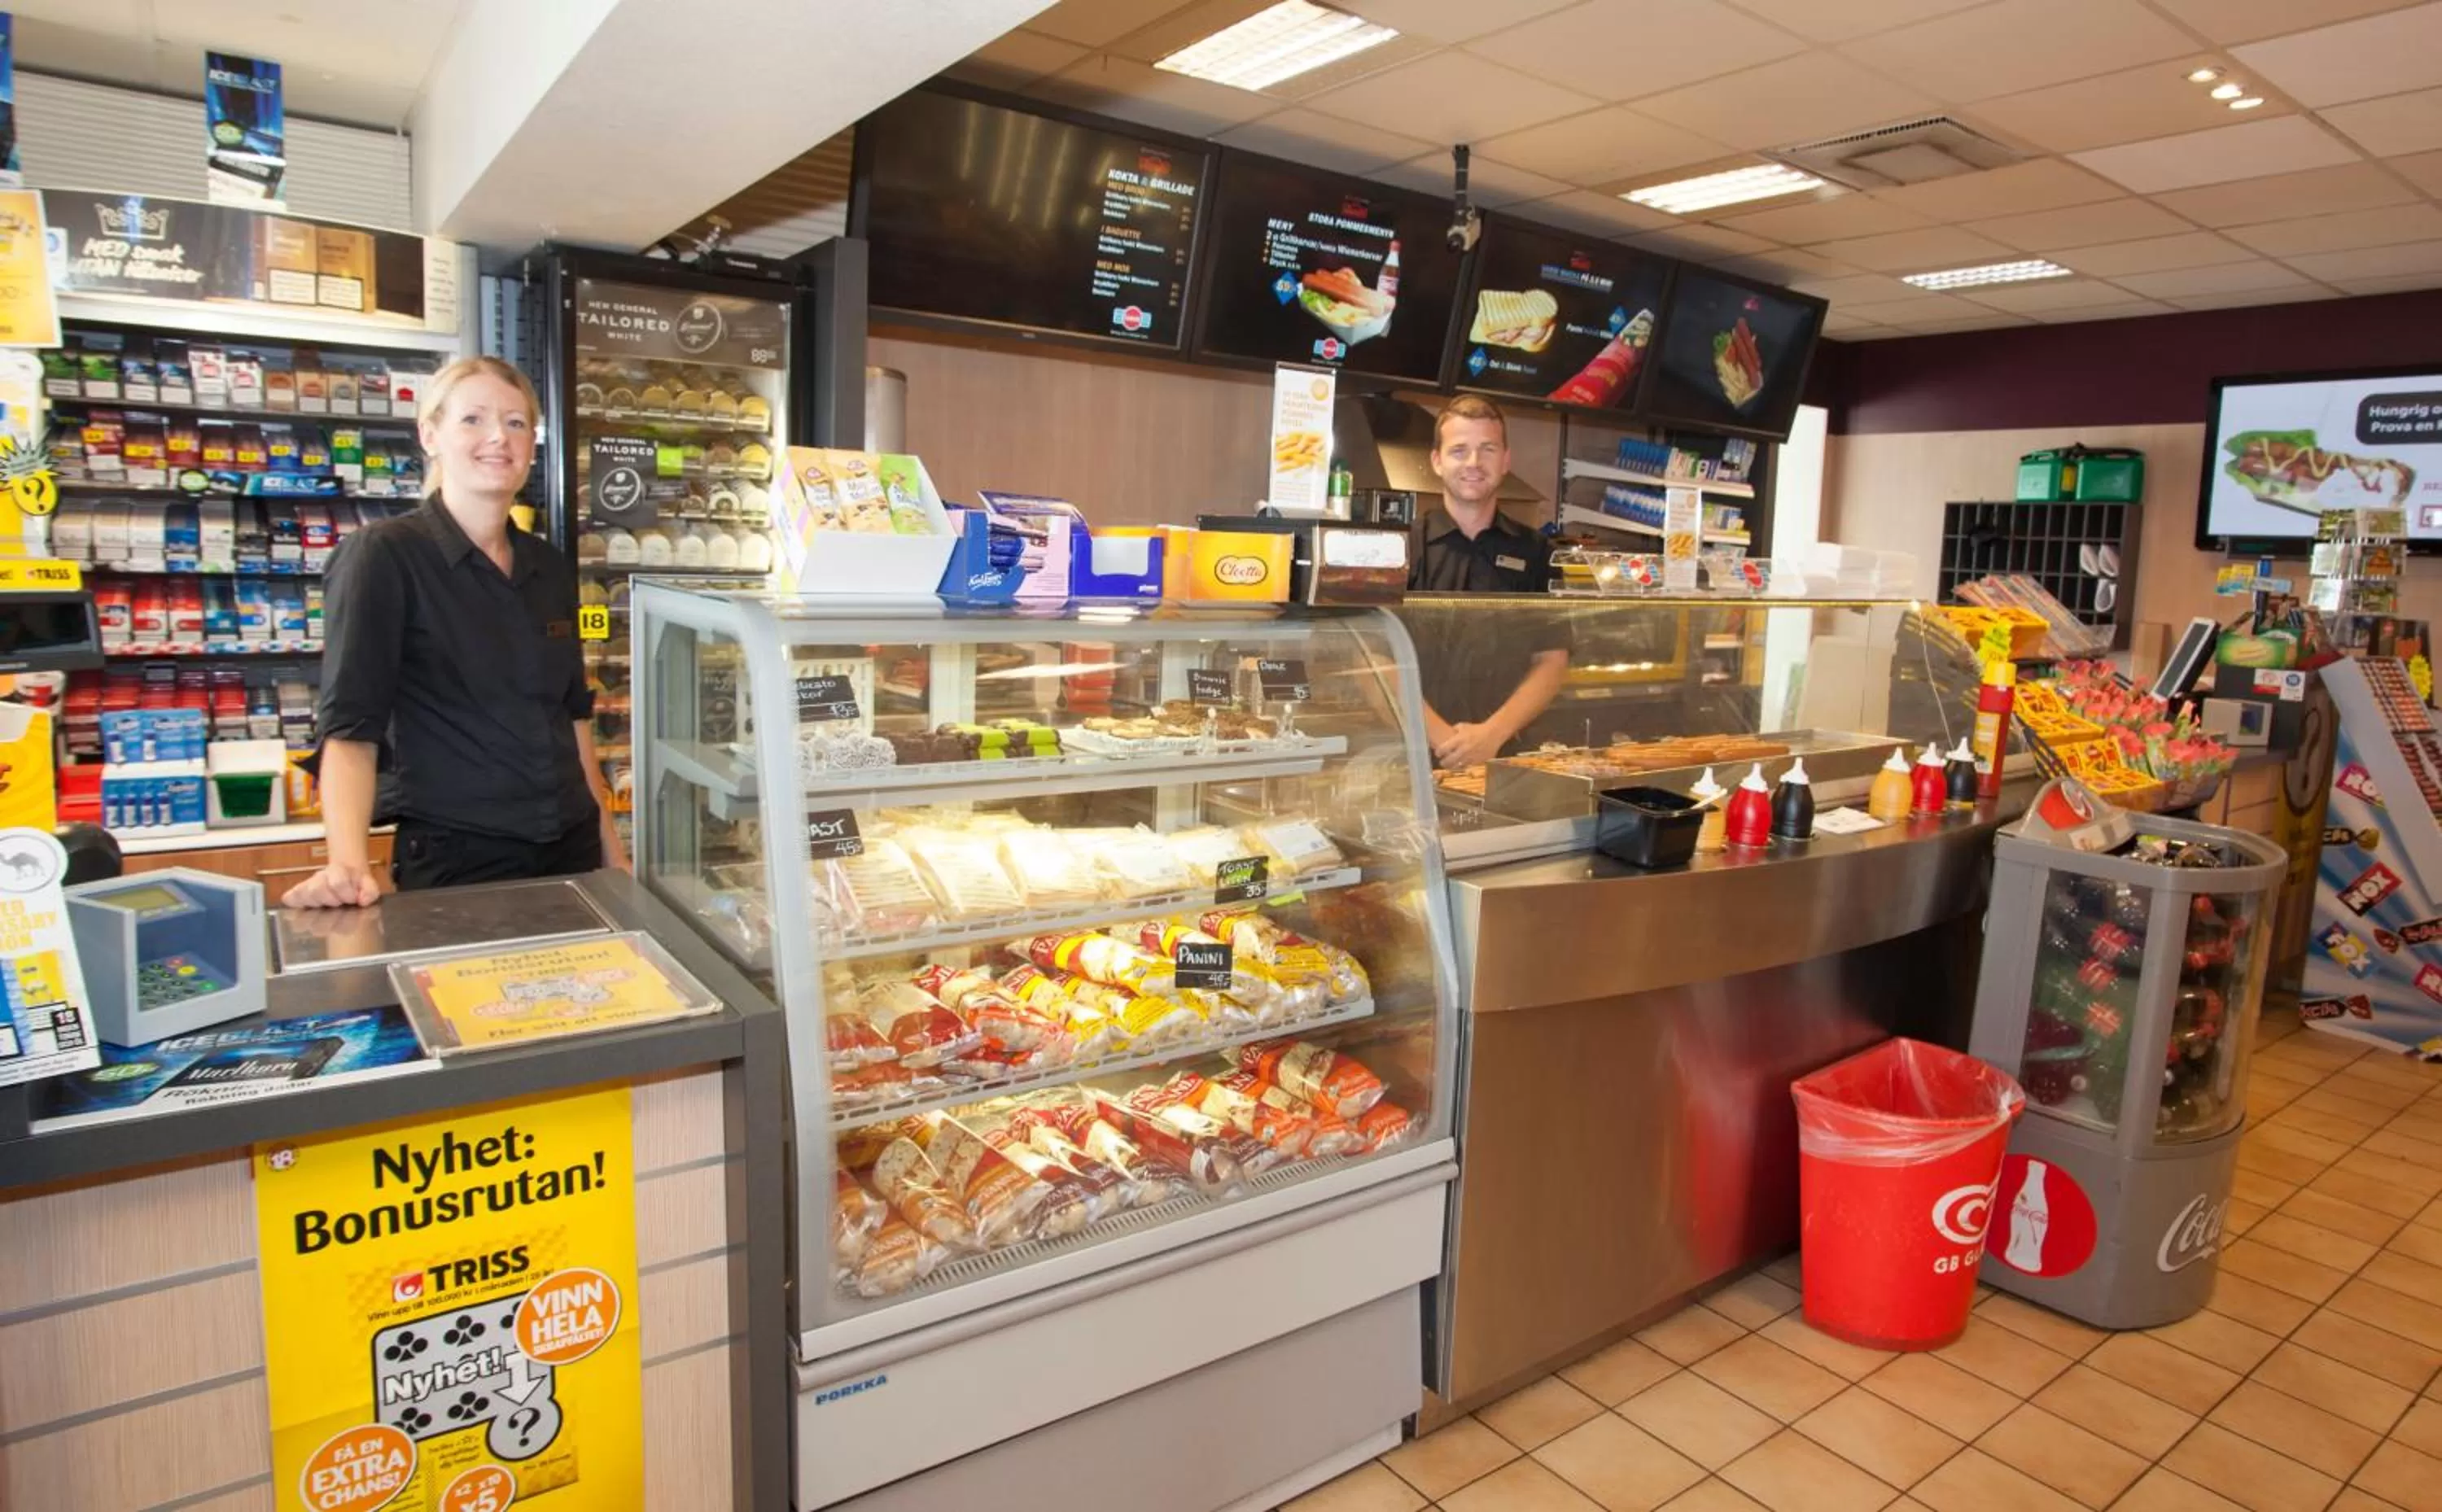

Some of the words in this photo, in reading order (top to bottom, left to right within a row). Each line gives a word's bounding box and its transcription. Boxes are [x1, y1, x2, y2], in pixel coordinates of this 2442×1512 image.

[589, 299, 610, 310] NEW
[613, 302, 658, 316] GENERAL
[578, 312, 670, 333] TAILORED
[607, 331, 641, 342] WHITE
[2369, 404, 2429, 419] Hungrig
[2370, 420, 2412, 433] Prova
[2414, 422, 2434, 431] en
[593, 444, 654, 456] TAILORED
[37, 568, 71, 580] TRISS
[583, 613, 605, 629] 18
[2346, 869, 2393, 912] NOX
[1178, 944, 1223, 966] PANINI
[186, 1060, 299, 1081] Marlboro
[270, 1148, 295, 1168] 18
[372, 1126, 536, 1194] Nyhet:
[294, 1151, 606, 1255] Bonusrutan!
[427, 1244, 531, 1292] TRISS
[1933, 1255, 1960, 1274] GB
[530, 1278, 604, 1319] VINN
[531, 1304, 605, 1345] HELA
[383, 1346, 504, 1406] Nyhet!
[816, 1374, 889, 1406] PORKKA
[333, 1443, 356, 1463] FÅ
[361, 1437, 384, 1453] EN
[312, 1448, 407, 1494] EXTRA
[318, 1471, 401, 1510] CHANS!
[459, 1488, 497, 1512] x5
